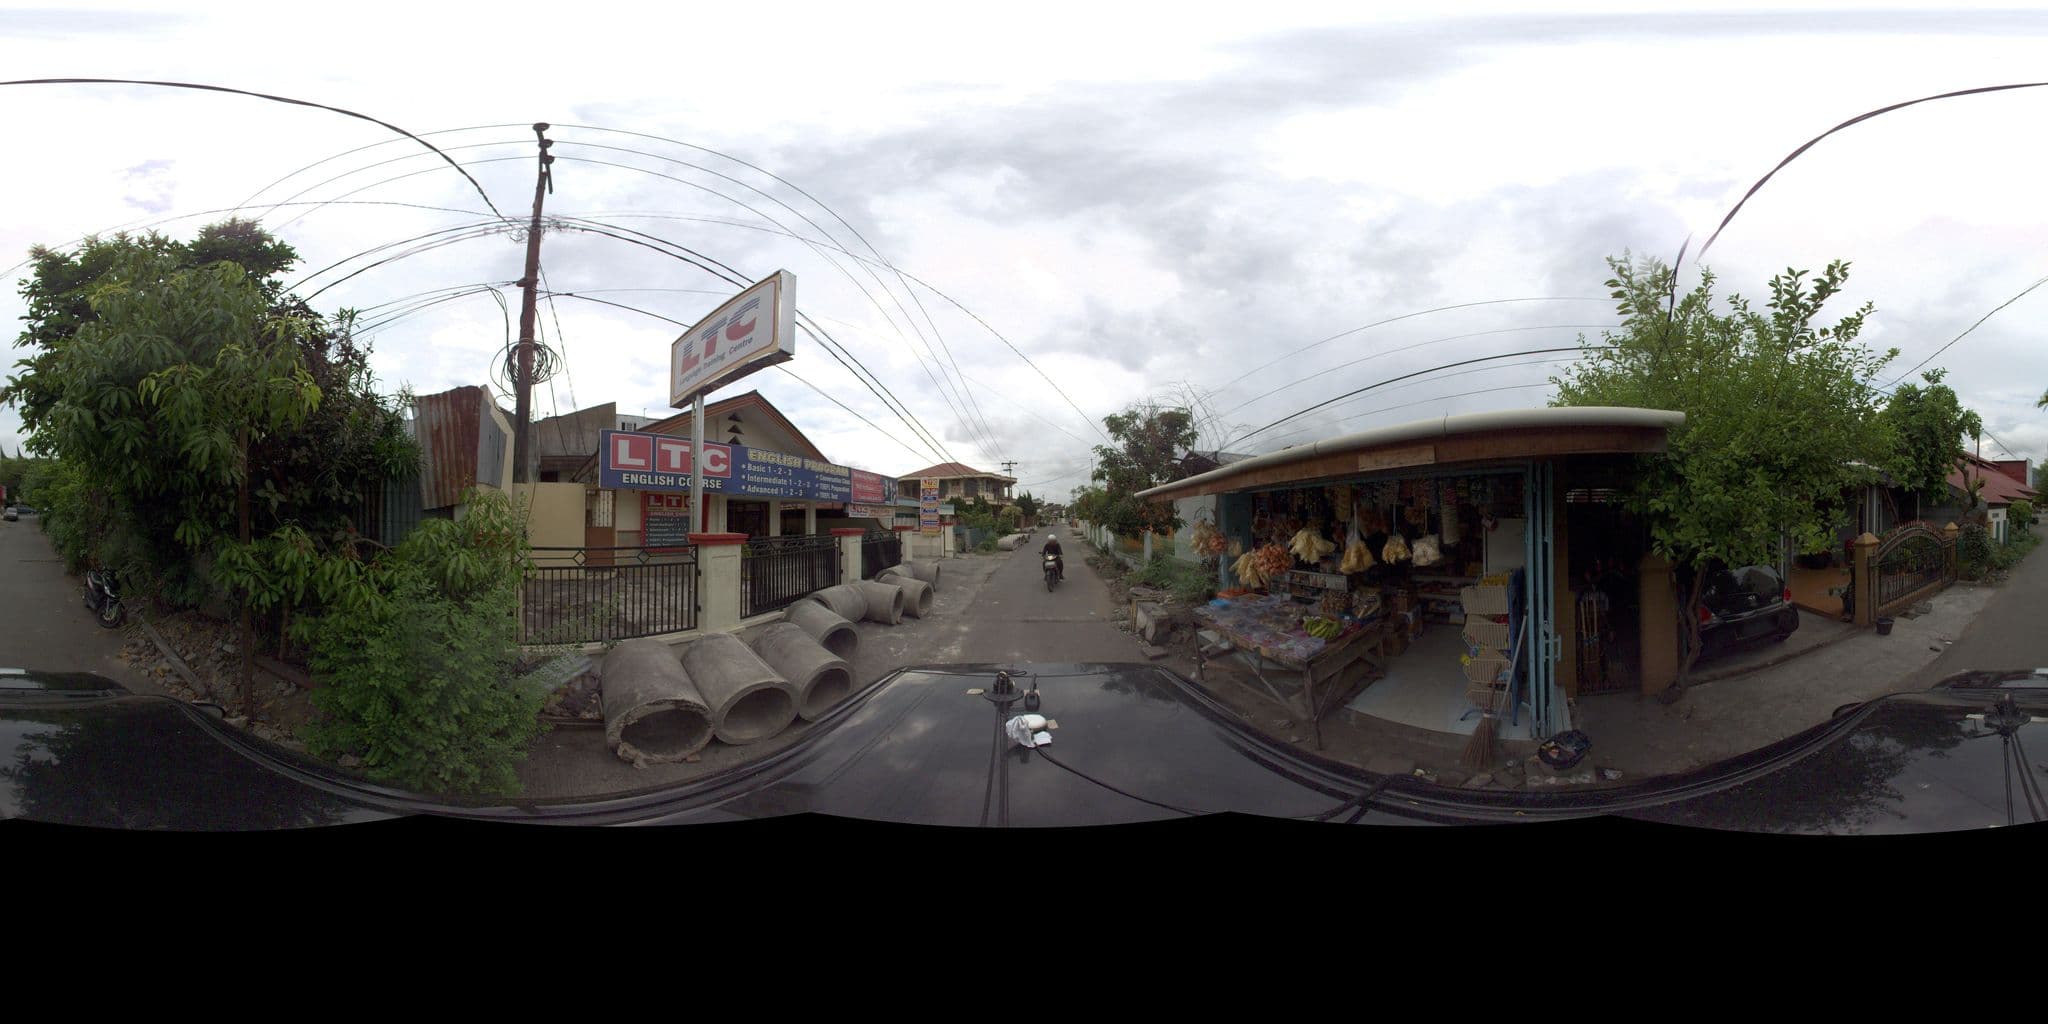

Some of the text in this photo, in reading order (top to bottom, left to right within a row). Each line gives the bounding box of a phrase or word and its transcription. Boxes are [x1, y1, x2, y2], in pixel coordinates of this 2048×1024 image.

[681, 297, 760, 375] LTC
[728, 337, 754, 354] Centre
[618, 440, 728, 472] LTC
[748, 448, 802, 468] ENGLISH
[803, 459, 849, 477] PROGRAM
[747, 463, 766, 473] Basic
[622, 473, 674, 486] ENGLISH
[747, 474, 788, 486] Intermediate
[747, 485, 780, 495] Advanced
